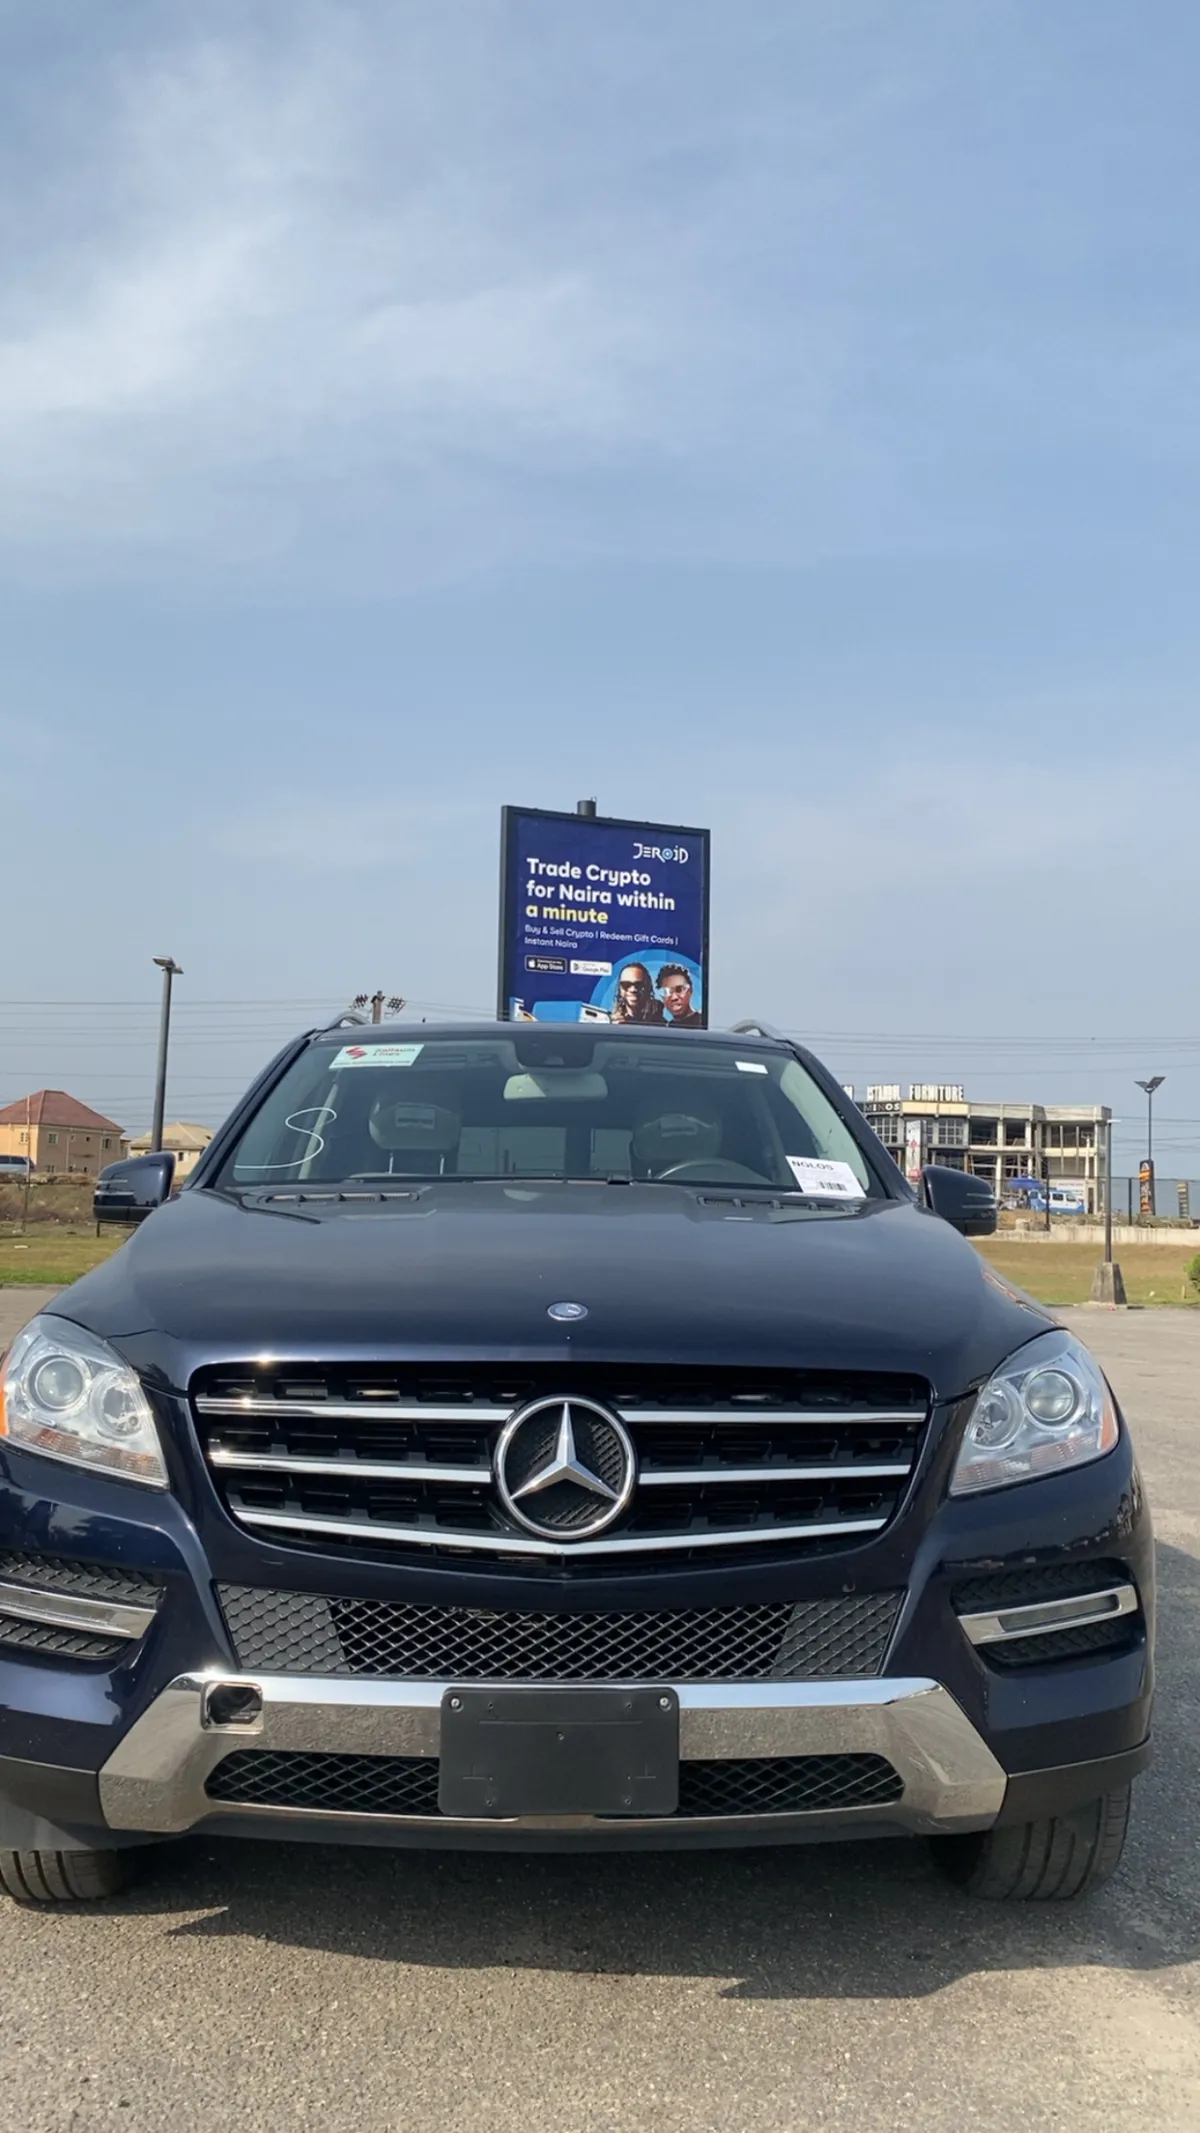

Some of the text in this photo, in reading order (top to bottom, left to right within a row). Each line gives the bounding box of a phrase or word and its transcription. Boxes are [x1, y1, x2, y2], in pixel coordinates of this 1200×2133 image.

[526, 857, 651, 887] Trade Crypto
[526, 880, 676, 911] for Naira within
[525, 904, 609, 924] a minute
[524, 936, 578, 949] Instant Naira
[525, 924, 541, 935] Buy
[542, 927, 549, 935] &
[549, 927, 565, 937] Sell
[565, 929, 594, 940] Crypto
[600, 931, 633, 942] Redeem
[634, 933, 650, 943] Gift
[650, 935, 674, 945] Cards
[909, 1084, 964, 1101] FURNITURE
